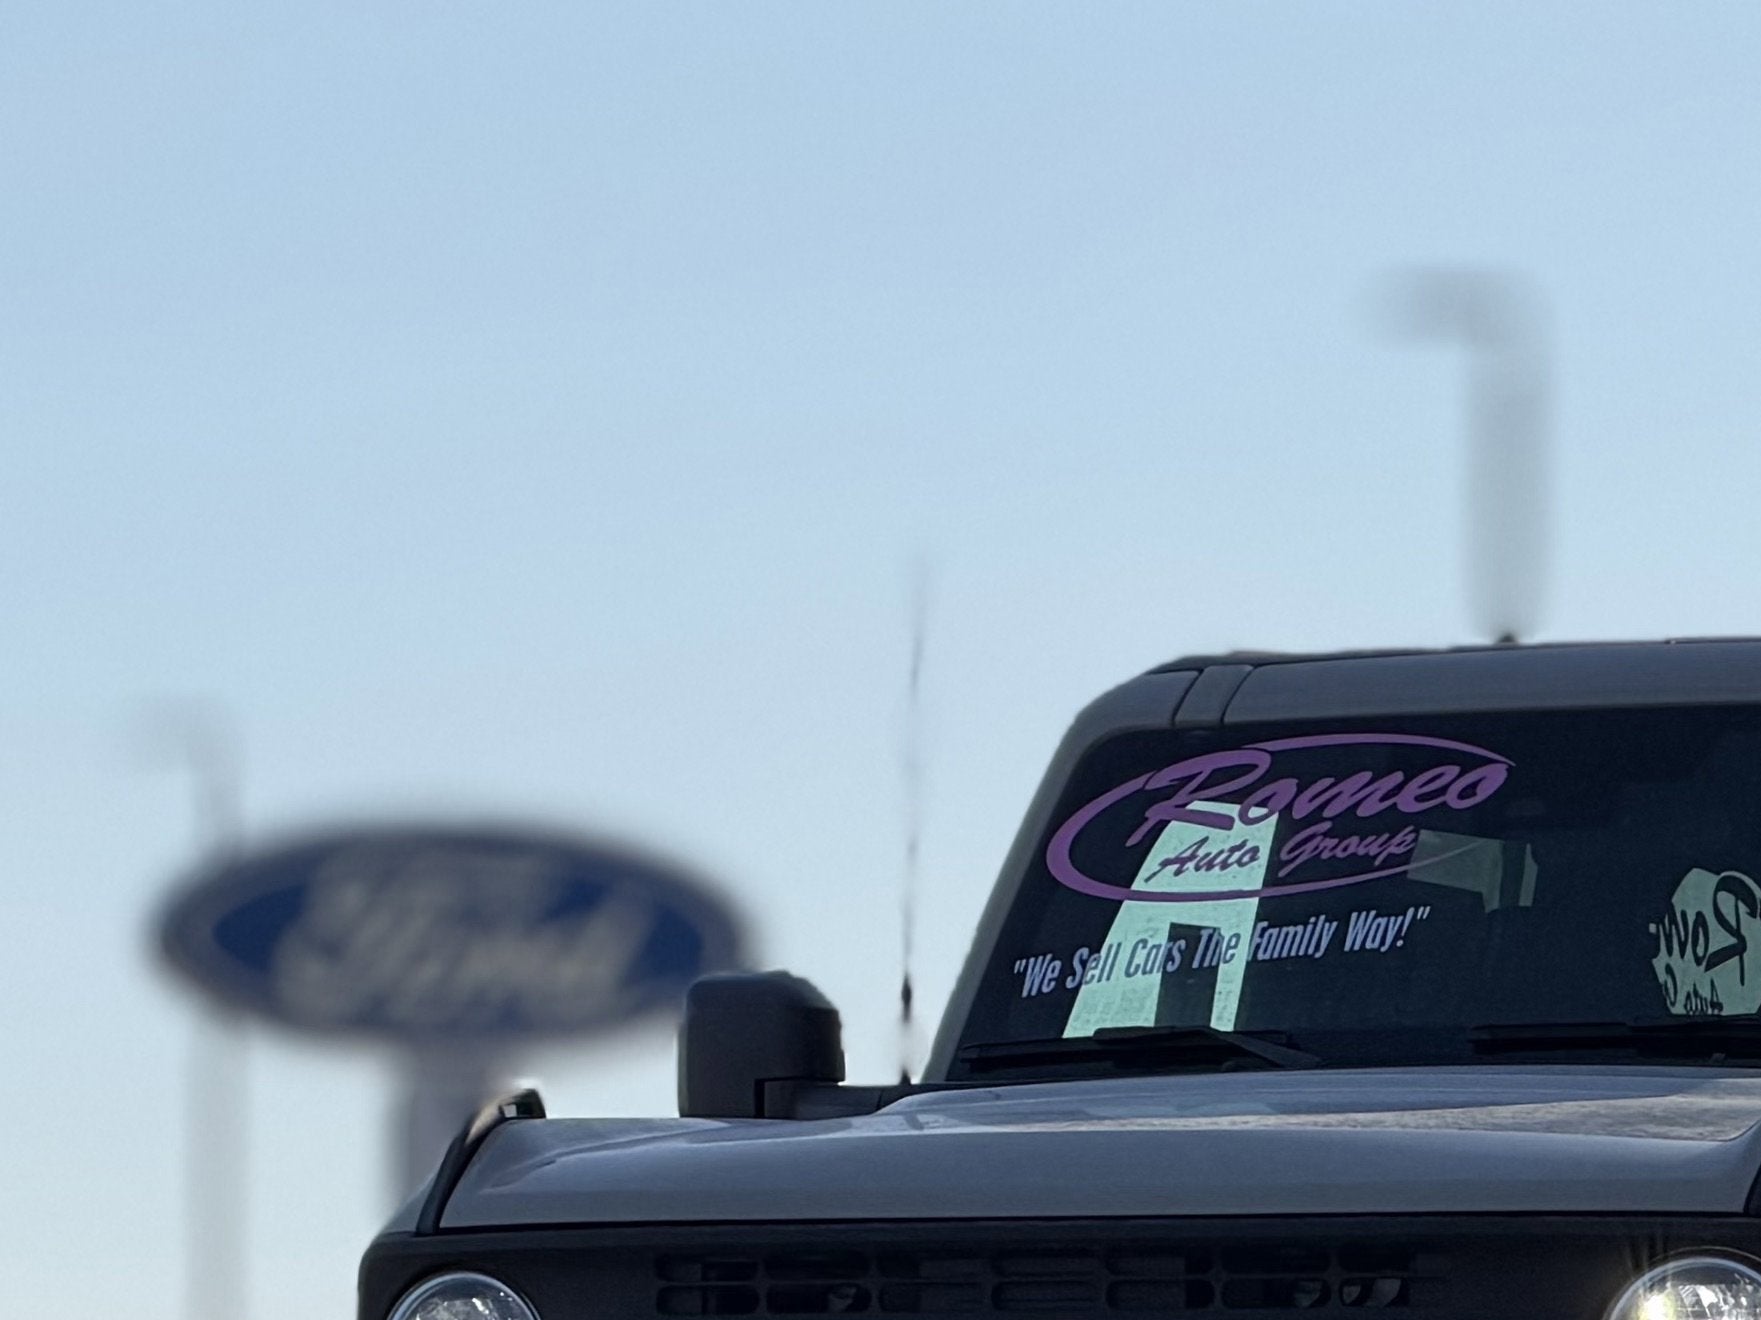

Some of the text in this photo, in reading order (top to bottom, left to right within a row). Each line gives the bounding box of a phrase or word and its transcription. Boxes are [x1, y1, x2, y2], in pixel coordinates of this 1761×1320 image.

[1125, 748, 1509, 847] Romeo
[1145, 821, 1418, 883] Auto Group
[1013, 906, 1431, 999] "We Sell Cars The Family Way!"
